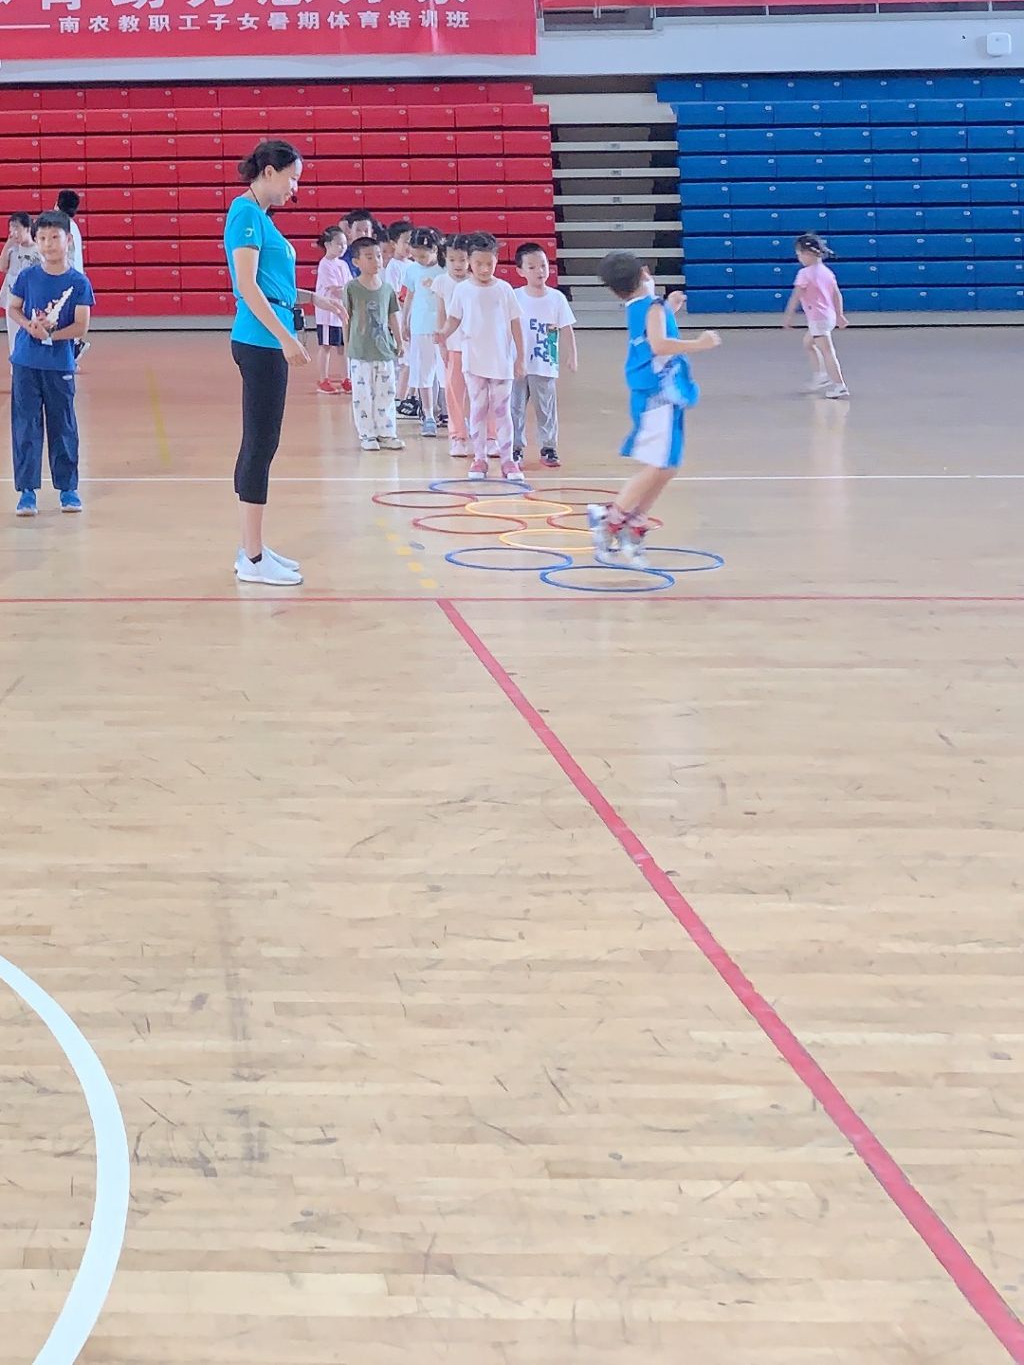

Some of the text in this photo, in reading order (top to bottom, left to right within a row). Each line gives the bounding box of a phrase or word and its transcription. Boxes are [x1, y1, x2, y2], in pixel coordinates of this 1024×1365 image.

[58, 10, 470, 34] 南农教职工子女暑期体育培训班
